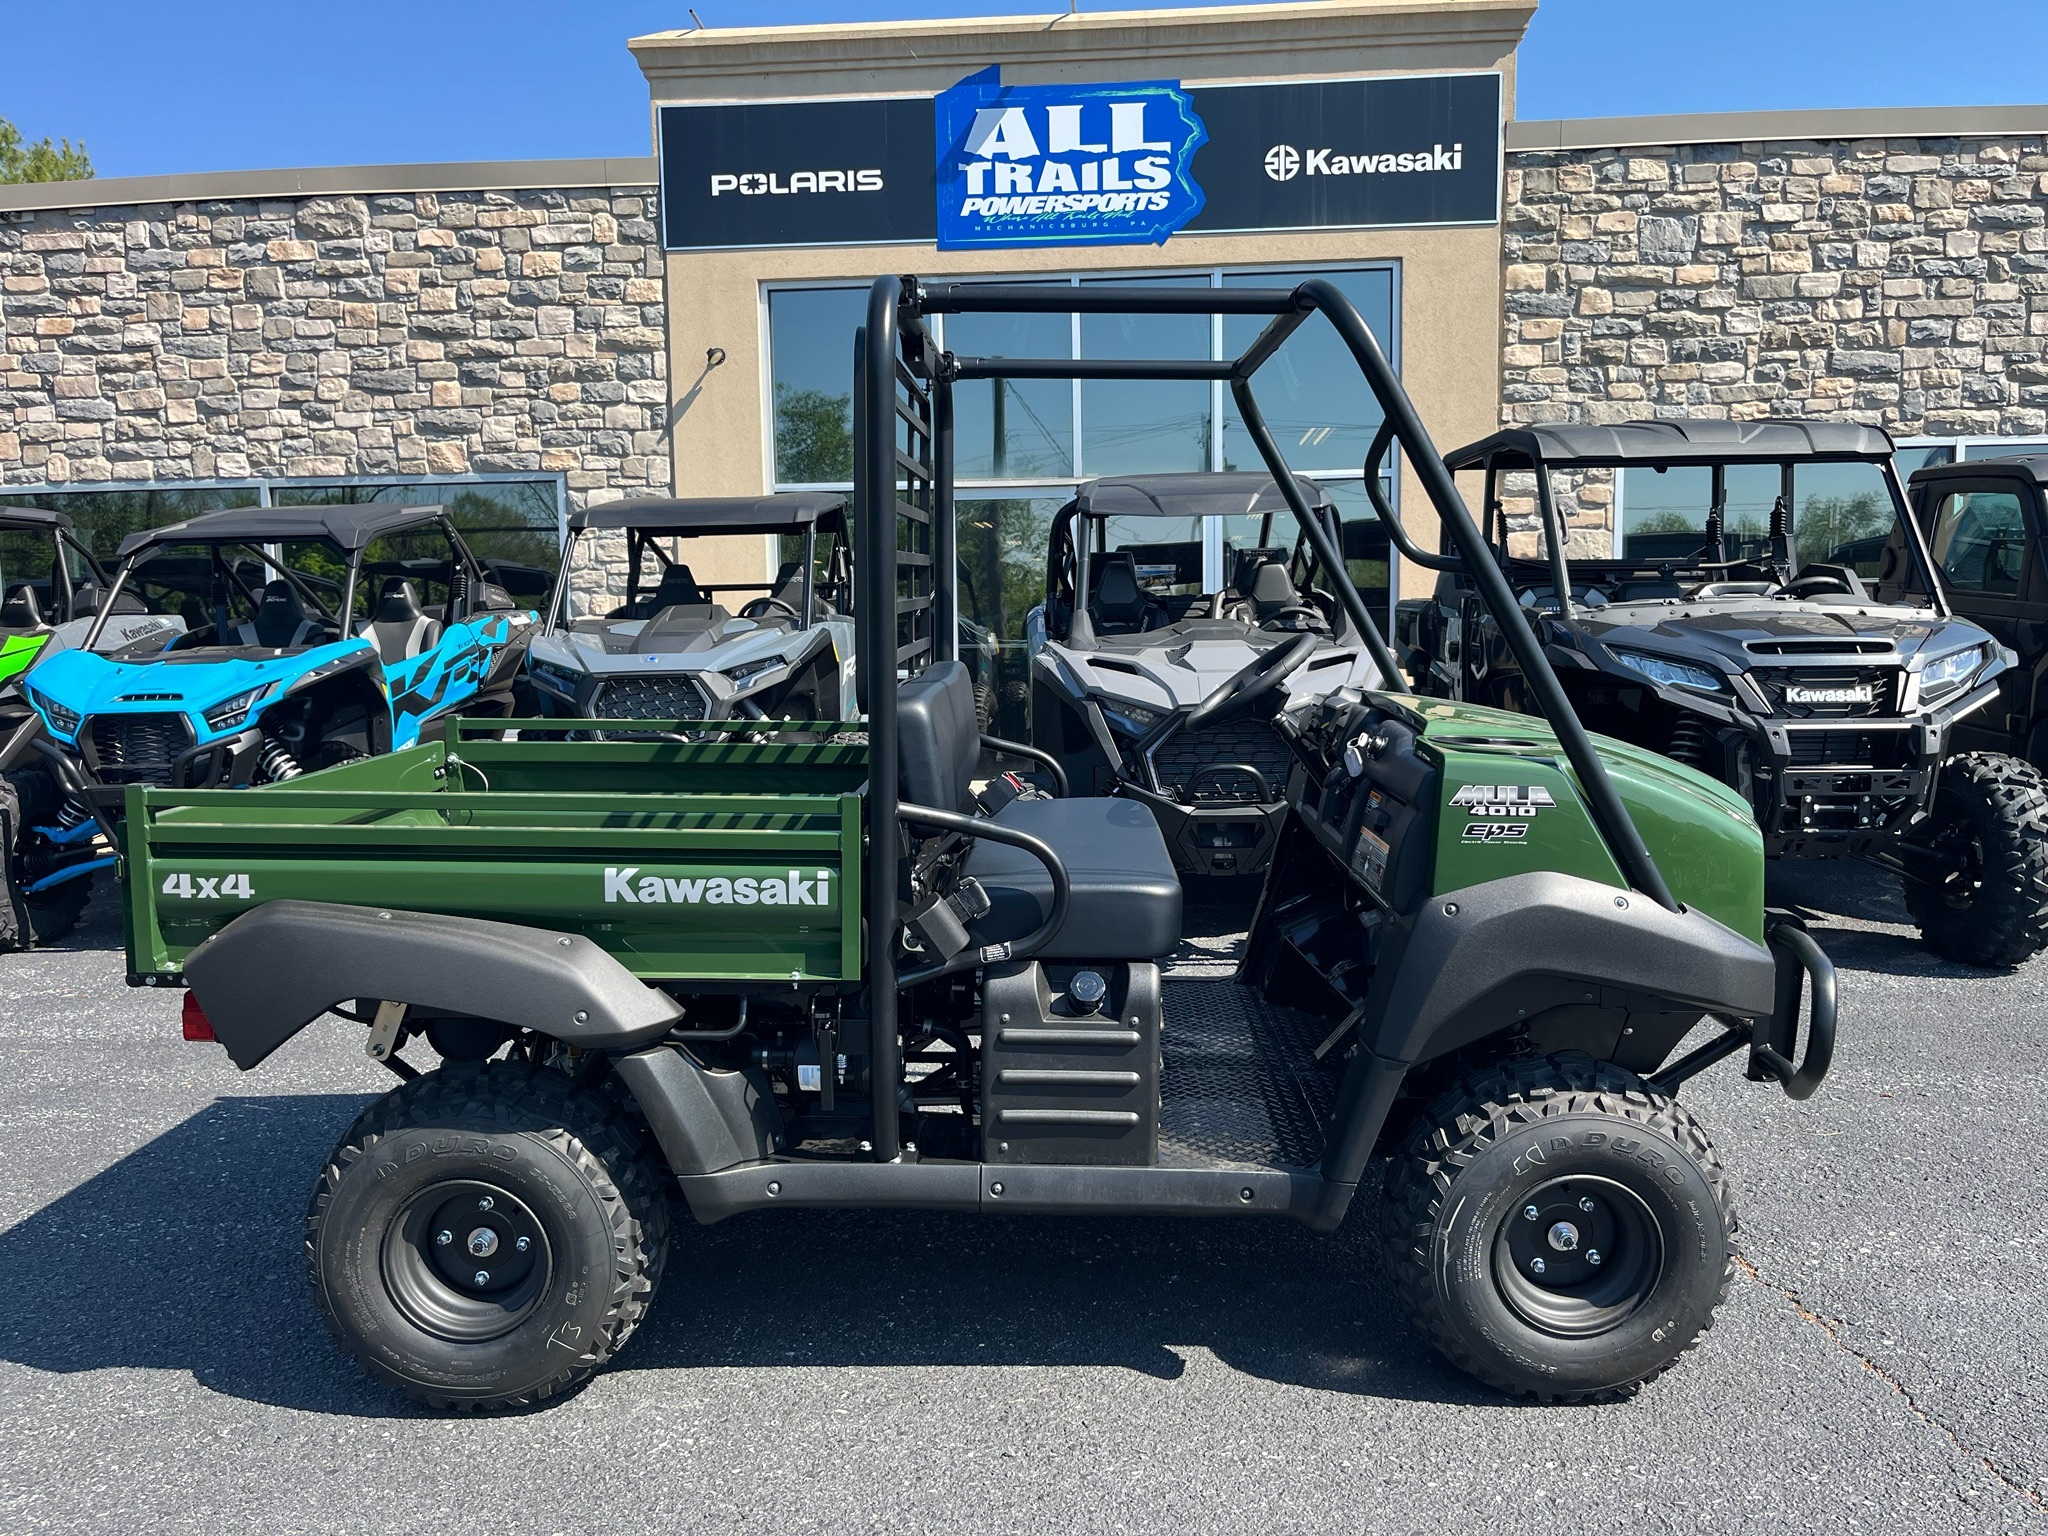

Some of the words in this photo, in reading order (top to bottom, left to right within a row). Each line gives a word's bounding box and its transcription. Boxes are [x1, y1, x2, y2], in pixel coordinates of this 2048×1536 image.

[963, 102, 1171, 160] ALL
[1305, 143, 1463, 176] Kawasaki
[711, 169, 884, 197] POLARIS
[958, 156, 1172, 195] TRAILS
[960, 191, 1171, 217] POWERSPORTS
[983, 213, 1028, 224] Where
[1031, 212, 1058, 222] All
[1062, 210, 1100, 221] Trails
[1786, 686, 1873, 703] Kawasaki
[1448, 785, 1557, 808] MULE
[1469, 806, 1537, 817] 4010
[1462, 823, 1529, 841] EPS
[161, 873, 256, 900] 4x4
[604, 866, 830, 907] Kawasaki
[404, 1136, 519, 1164] DURO
[1580, 1131, 1687, 1186] DURO
